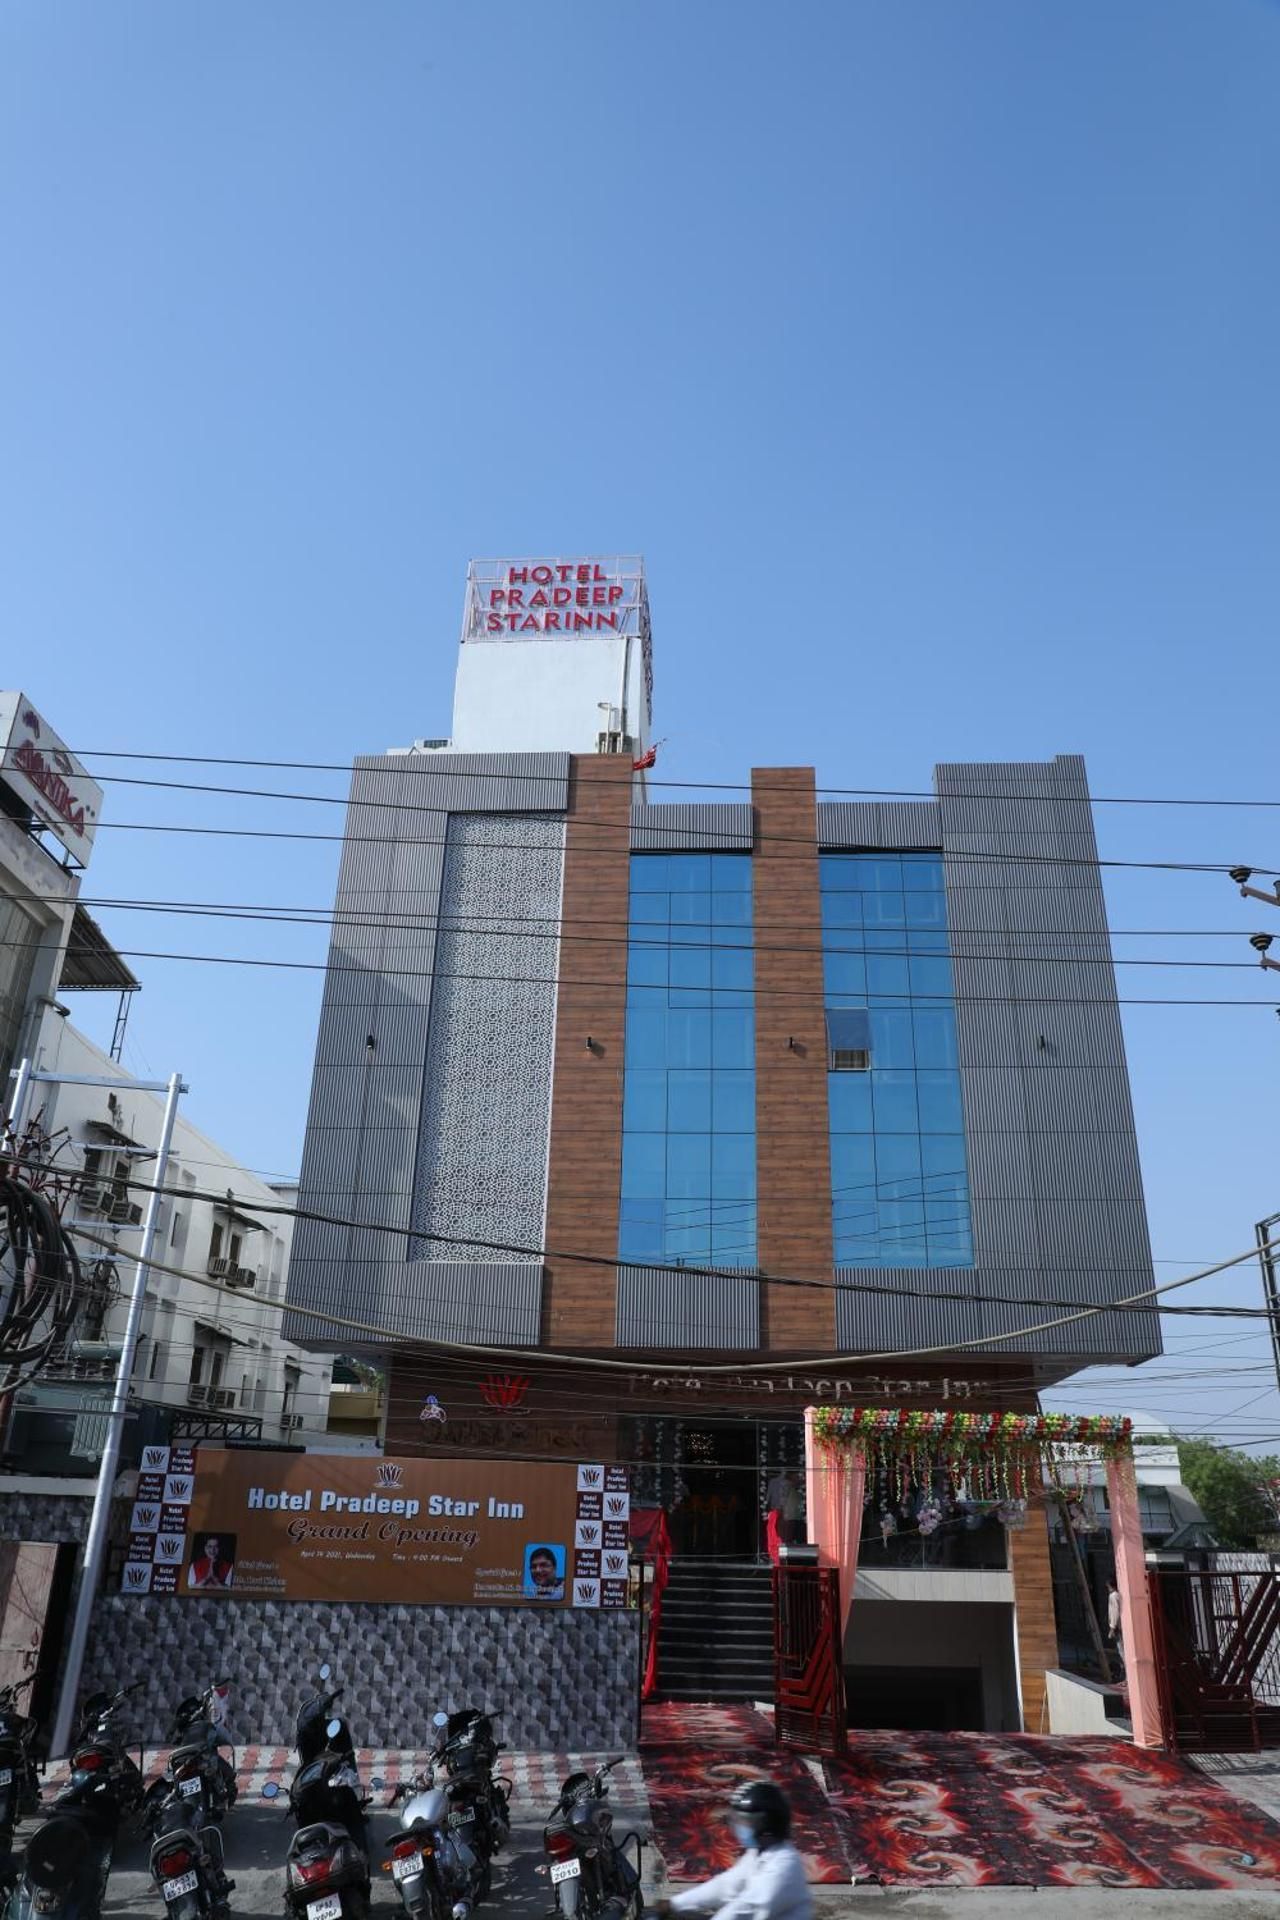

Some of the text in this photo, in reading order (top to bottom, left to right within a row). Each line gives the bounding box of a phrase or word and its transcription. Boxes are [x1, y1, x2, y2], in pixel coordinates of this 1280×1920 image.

[509, 564, 607, 585] HOTEL
[490, 586, 624, 608] PRADEEP
[487, 611, 617, 632] STARINN
[247, 1487, 525, 1519] Hotel Pradeep Star Inn
[287, 1518, 480, 1548] Grand Opening
[553, 1867, 579, 1881] 2010
